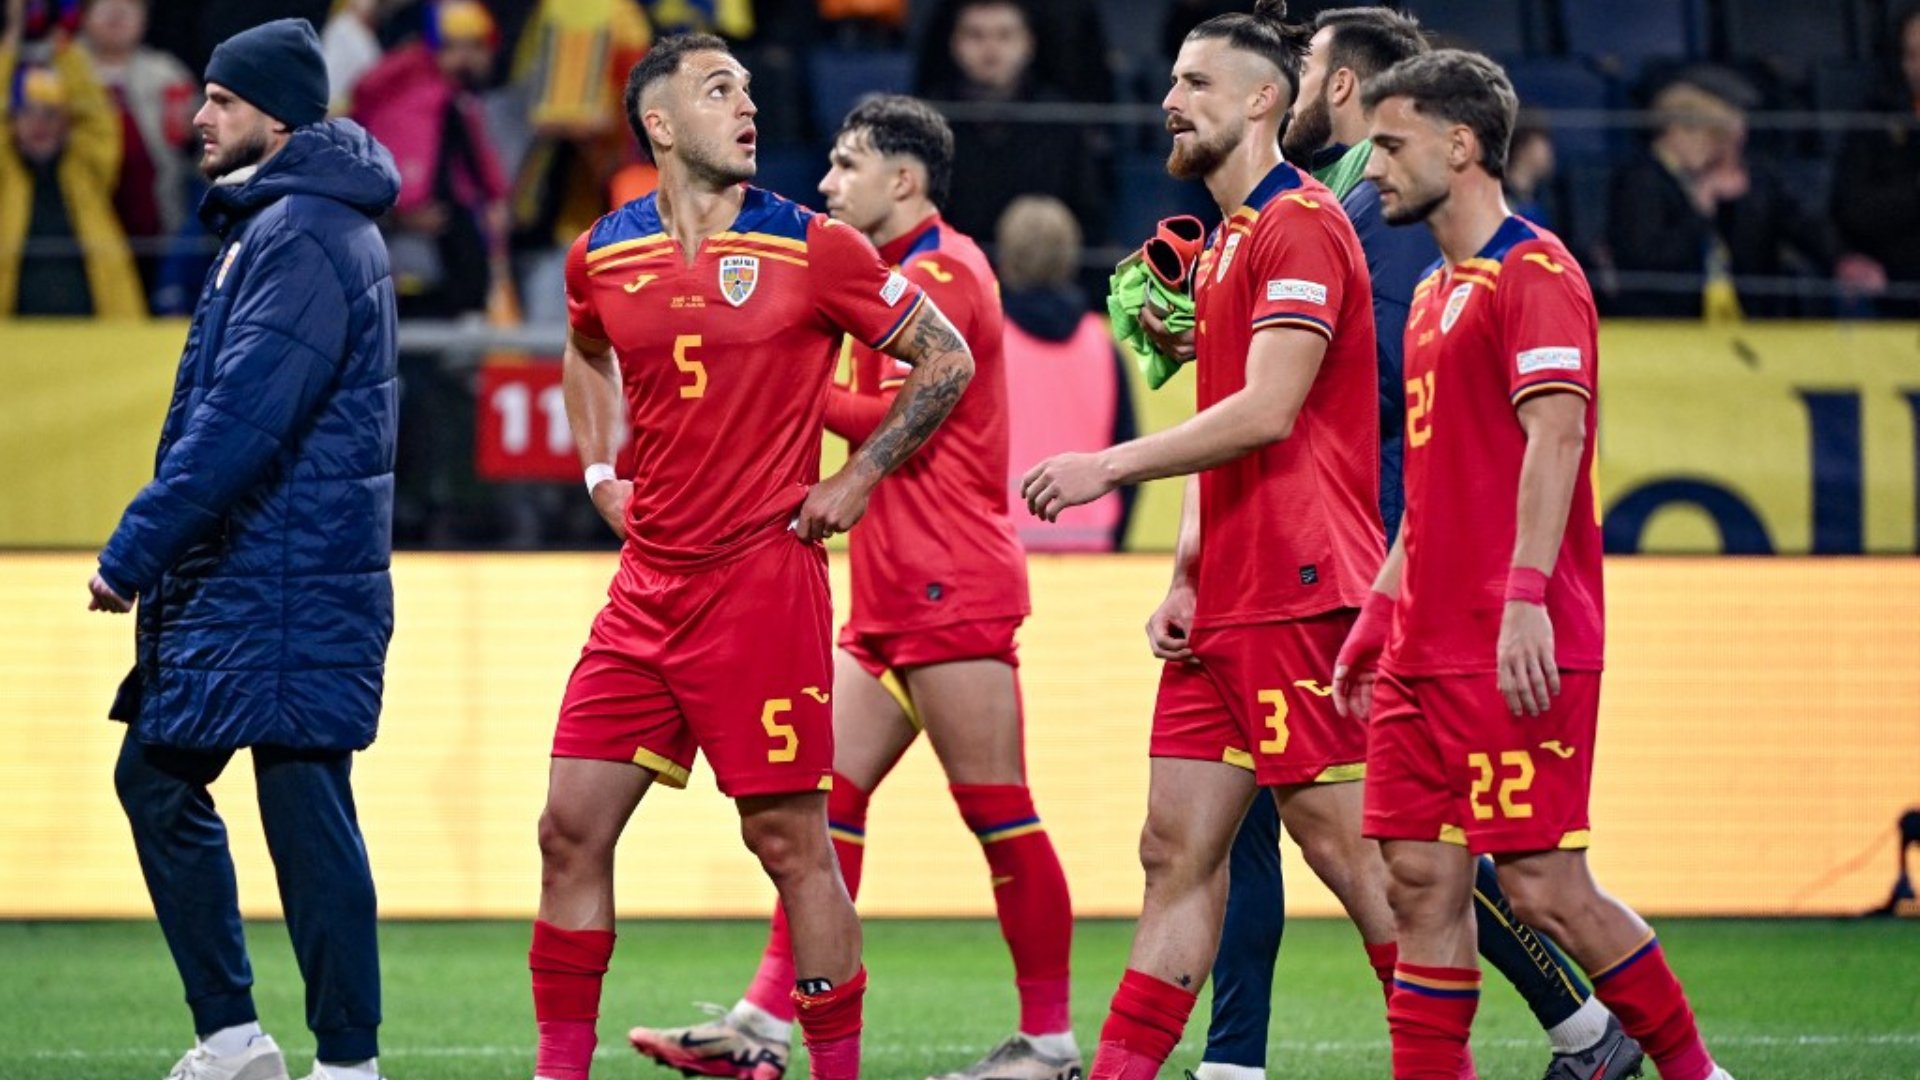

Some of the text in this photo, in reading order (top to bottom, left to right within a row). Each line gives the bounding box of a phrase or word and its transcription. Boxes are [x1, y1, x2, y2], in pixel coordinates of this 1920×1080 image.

[673, 335, 708, 398] 5
[761, 698, 799, 763] 5
[1257, 690, 1290, 754] 3
[1468, 751, 1535, 820] 22
